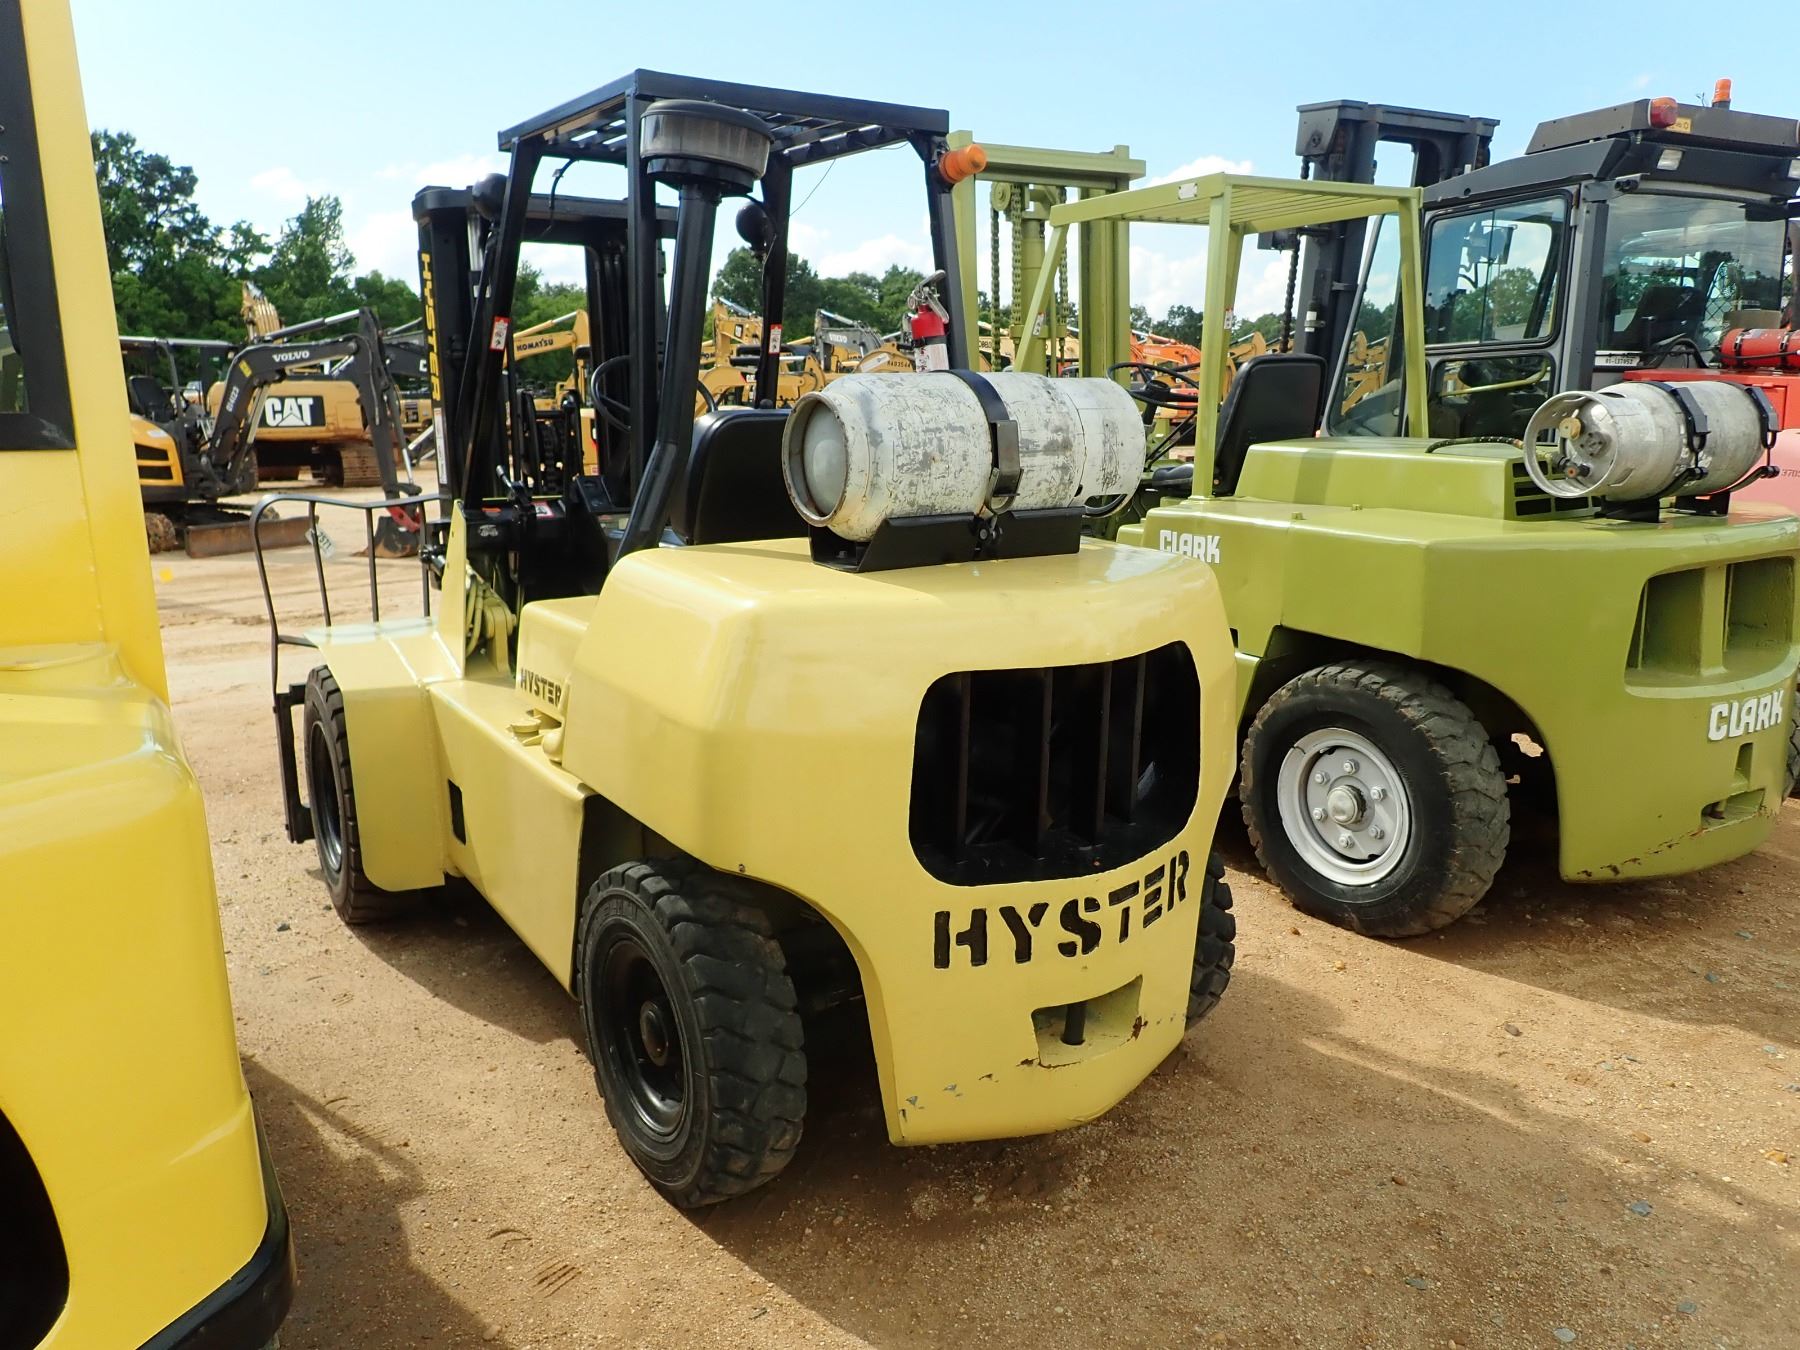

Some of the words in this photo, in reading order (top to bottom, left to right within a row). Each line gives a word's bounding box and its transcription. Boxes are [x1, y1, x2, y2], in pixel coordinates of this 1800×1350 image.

[421, 252, 441, 401] HYSTER
[516, 338, 554, 351] KOMATSU
[272, 350, 310, 362] VOLVO
[264, 397, 314, 427] CAT
[1160, 530, 1220, 564] CLARK
[521, 668, 561, 707] HYSTER
[1708, 690, 1784, 741] CLARK
[934, 850, 1190, 969] HYSTER
